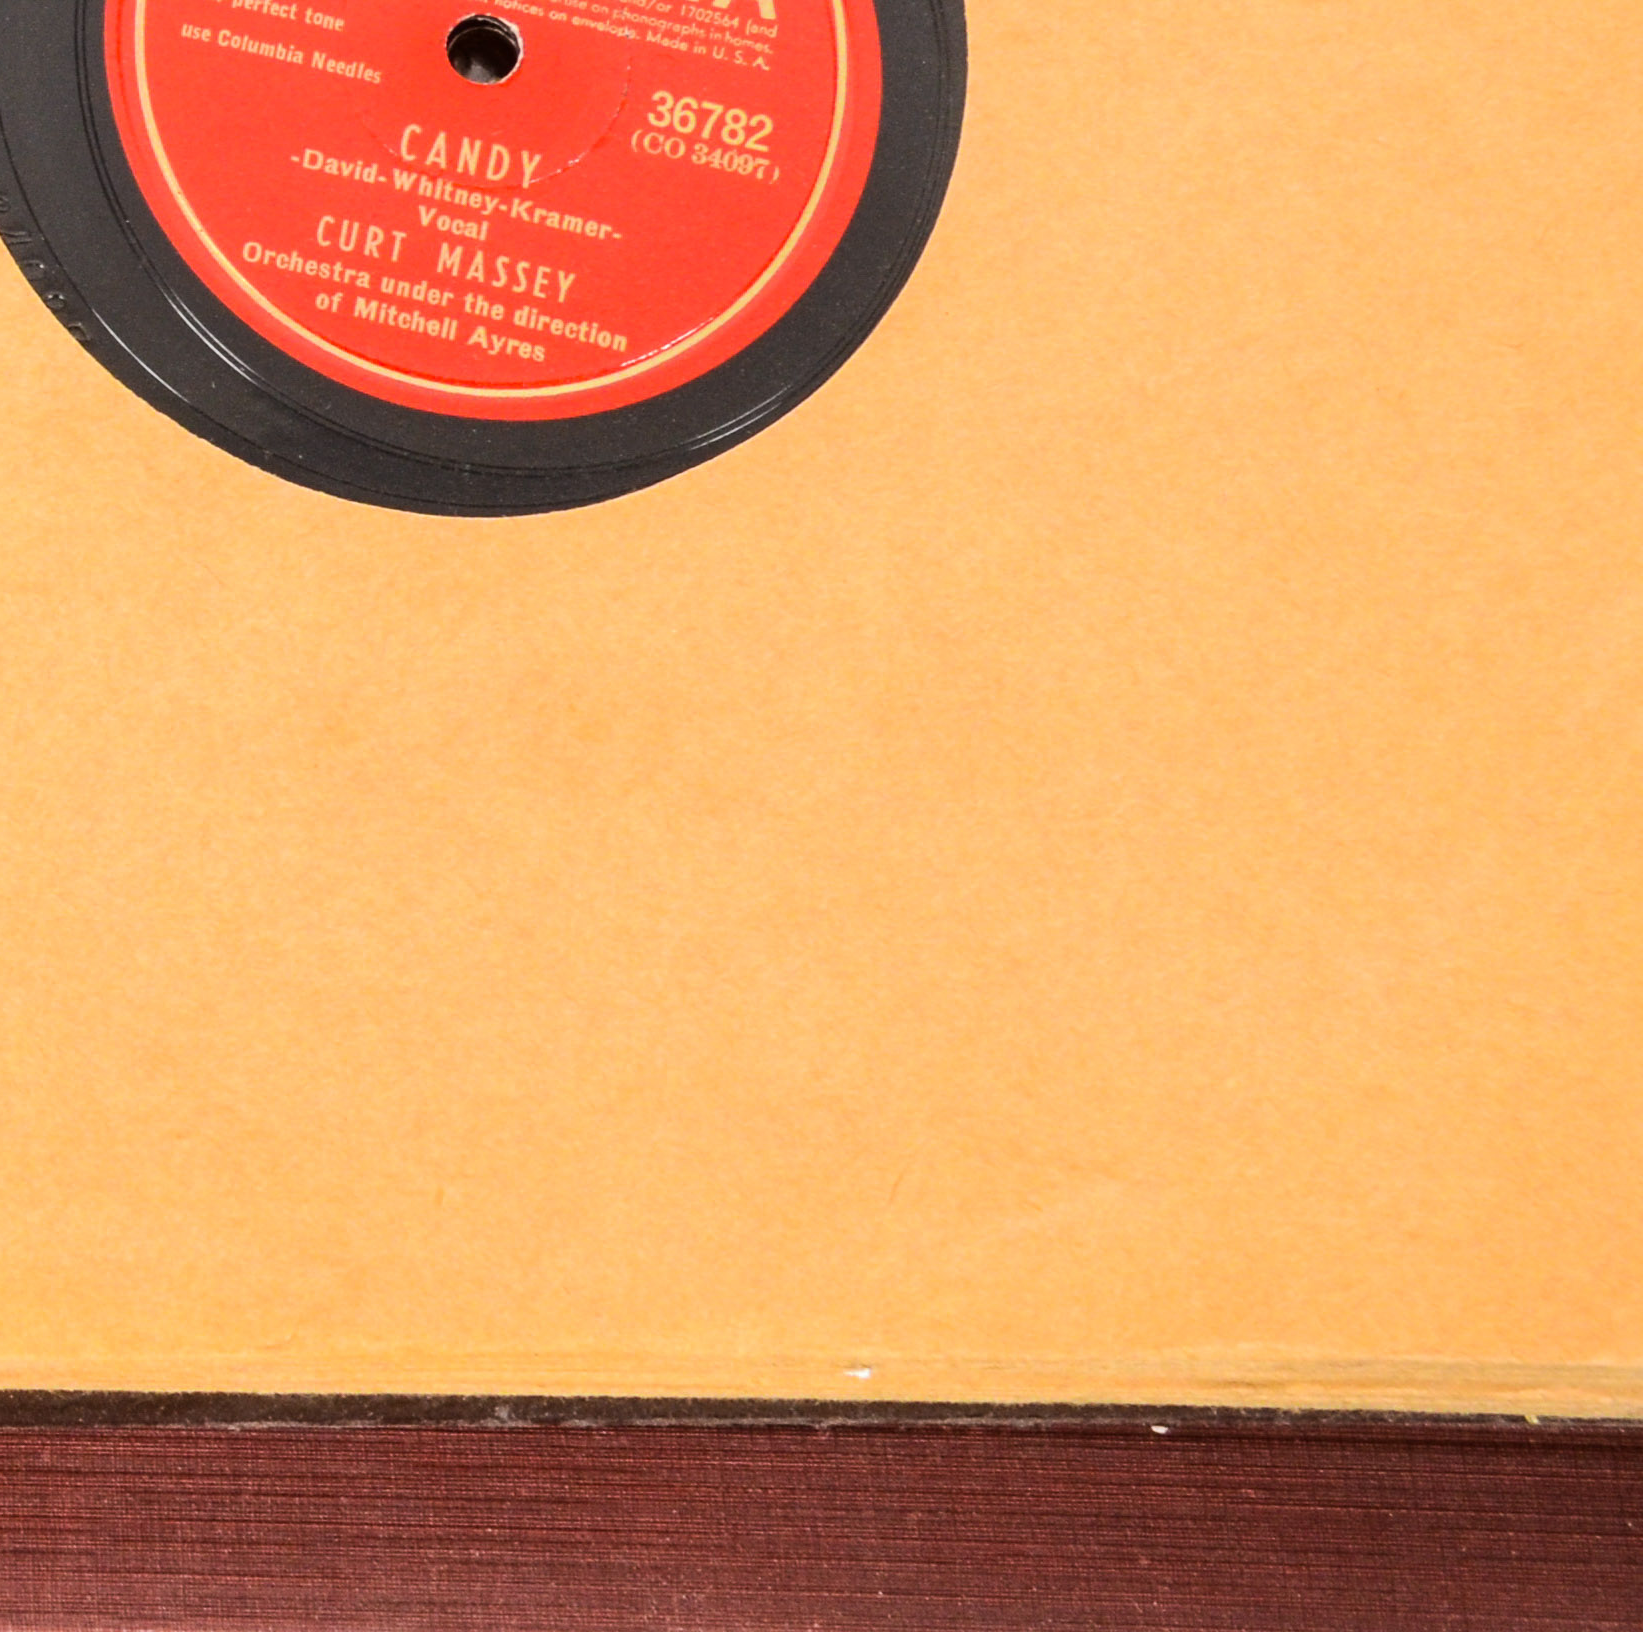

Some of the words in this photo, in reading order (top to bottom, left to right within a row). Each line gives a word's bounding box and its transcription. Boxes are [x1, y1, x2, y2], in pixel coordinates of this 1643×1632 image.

[304, 7, 346, 32] tone
[548, 9, 568, 22] on
[646, 30, 689, 53] Made
[693, 41, 707, 56] in
[712, 47, 729, 61] U.
[733, 50, 748, 66] S.
[591, 2, 609, 15] on
[613, 7, 706, 37] phonographs
[709, 27, 723, 41] in
[680, 4, 740, 29] 1702564
[180, 23, 212, 43] use
[217, 29, 304, 65] Columbia
[311, 50, 383, 85] Needles
[647, 90, 774, 152] 36782
[400, 123, 542, 189] CANDY
[631, 129, 687, 159] (CO
[690, 142, 781, 185] 34097)
[418, 206, 489, 241] Vocal
[317, 215, 407, 263] CURT
[436, 242, 577, 304] MASSEY
[242, 241, 371, 289] Orchestra
[380, 277, 455, 307] under
[463, 293, 505, 321] the
[514, 305, 629, 353] direction
[315, 292, 343, 312] of
[353, 296, 459, 342] Mitchell
[466, 326, 547, 363] Ayres
